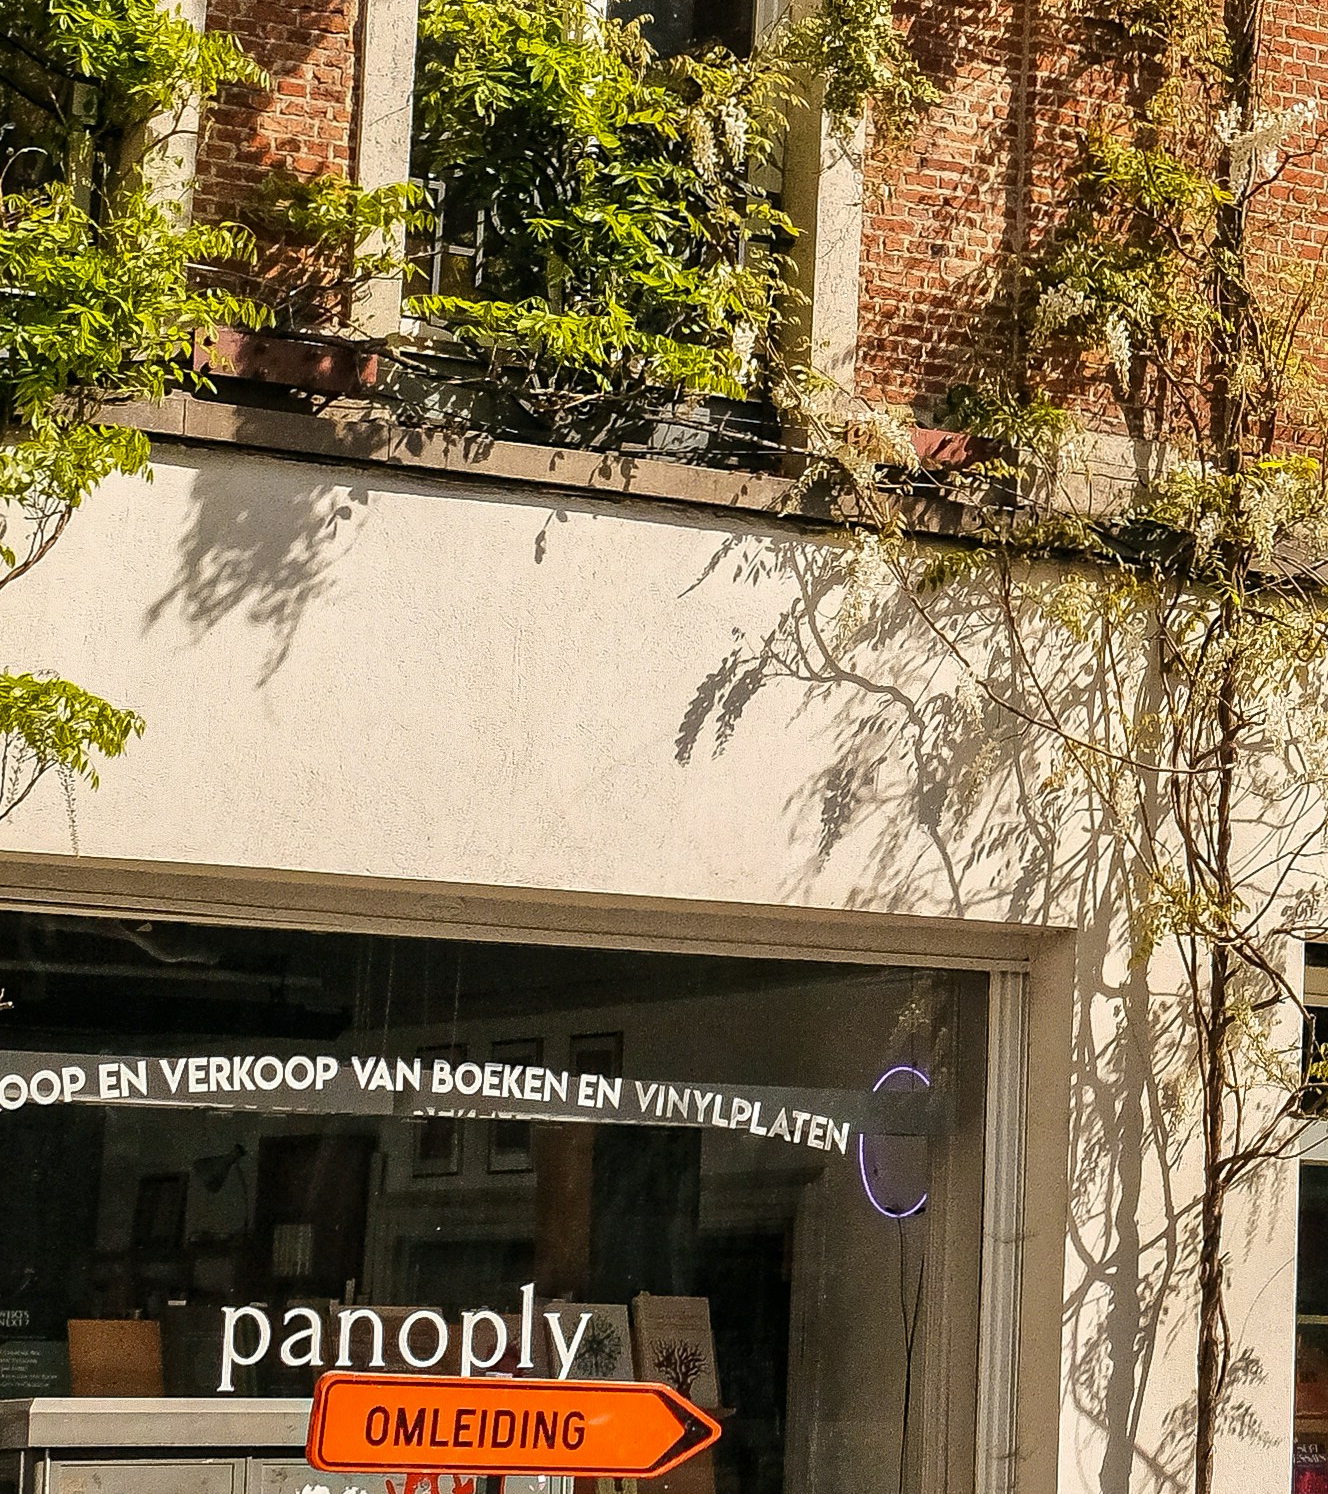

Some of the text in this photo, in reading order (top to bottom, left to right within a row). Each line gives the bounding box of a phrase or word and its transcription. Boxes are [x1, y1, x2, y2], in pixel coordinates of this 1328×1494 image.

[0, 1056, 851, 1155] OOP EN VERKOOP VAN BOEKEN EN VINYLPLATEN
[218, 1282, 593, 1393] panoply
[364, 1405, 587, 1451] OMLEIDING
